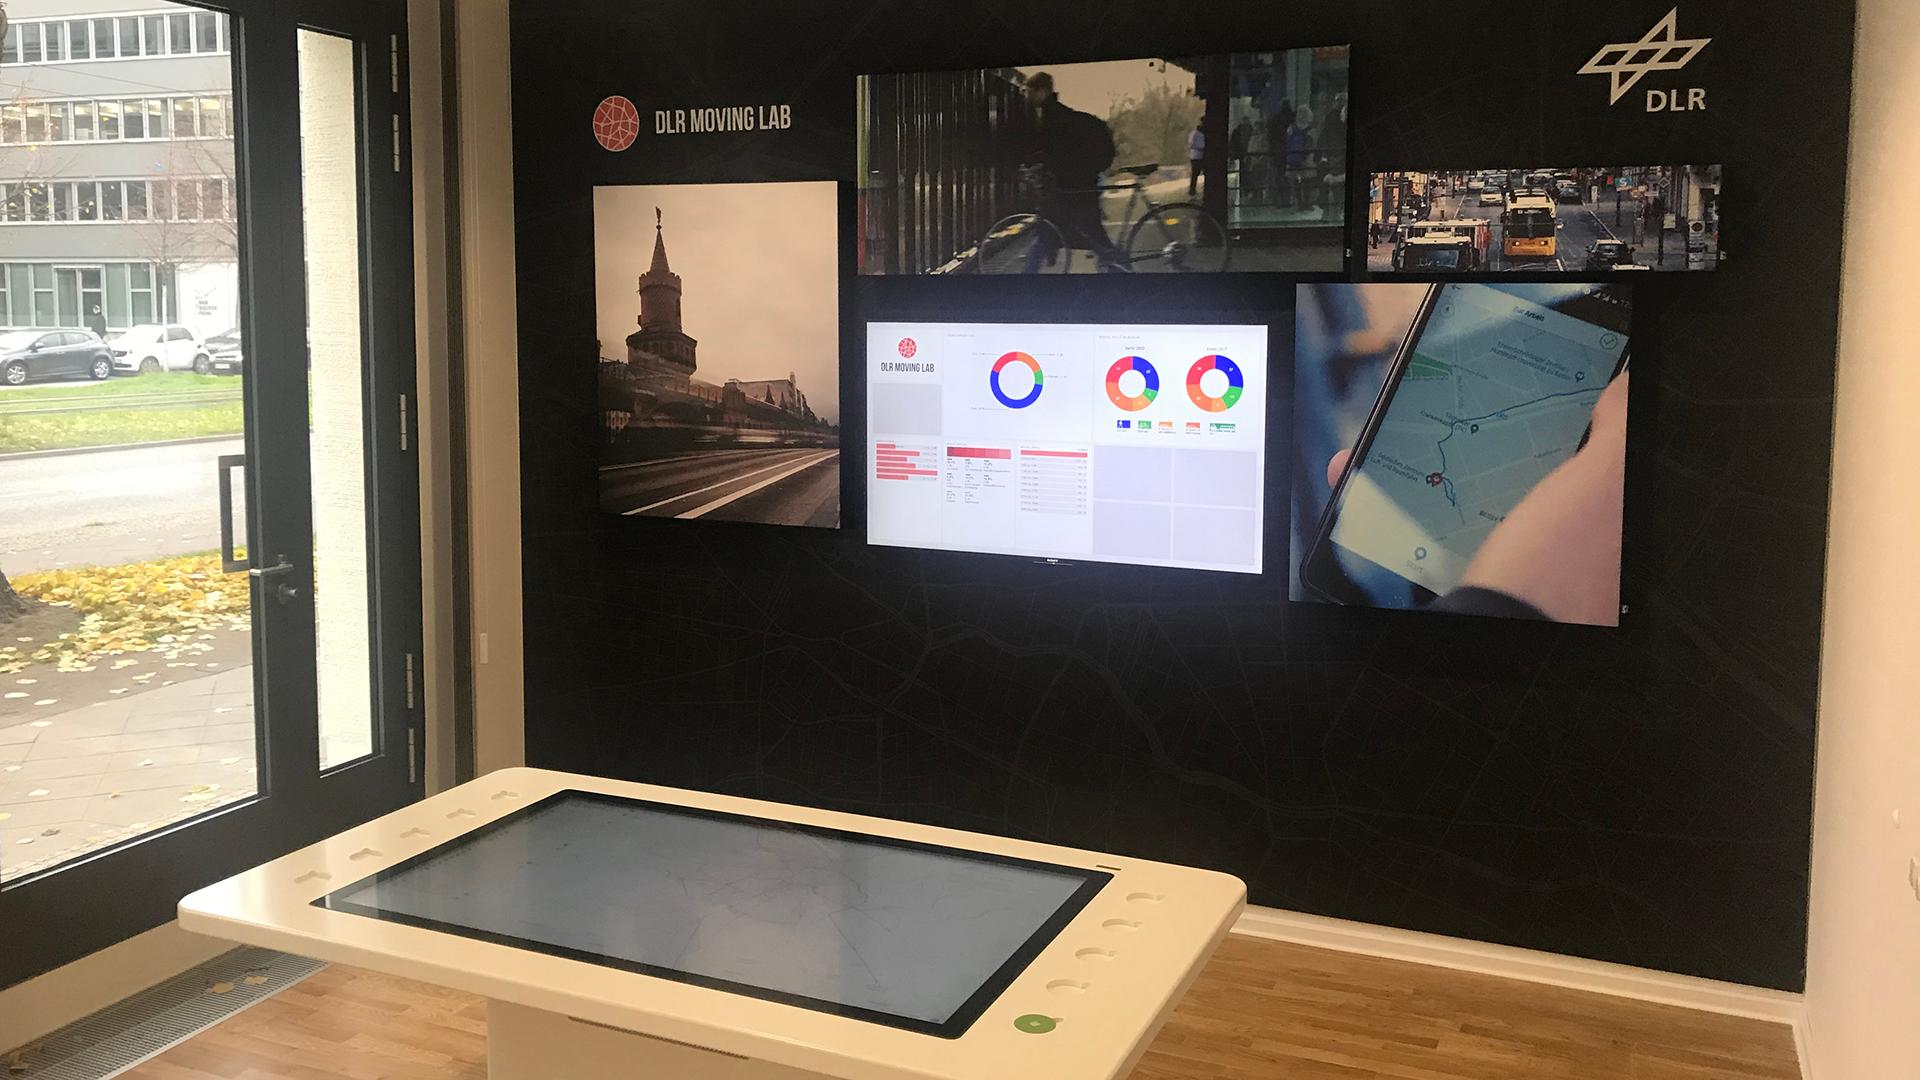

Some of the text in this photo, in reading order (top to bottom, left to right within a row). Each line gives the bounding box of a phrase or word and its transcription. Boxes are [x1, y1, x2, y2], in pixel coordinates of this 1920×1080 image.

[1646, 88, 1706, 112] DLR
[655, 105, 791, 134] DLR MOVING LAB
[895, 362, 921, 373] MOVING
[922, 363, 935, 373] LAB
